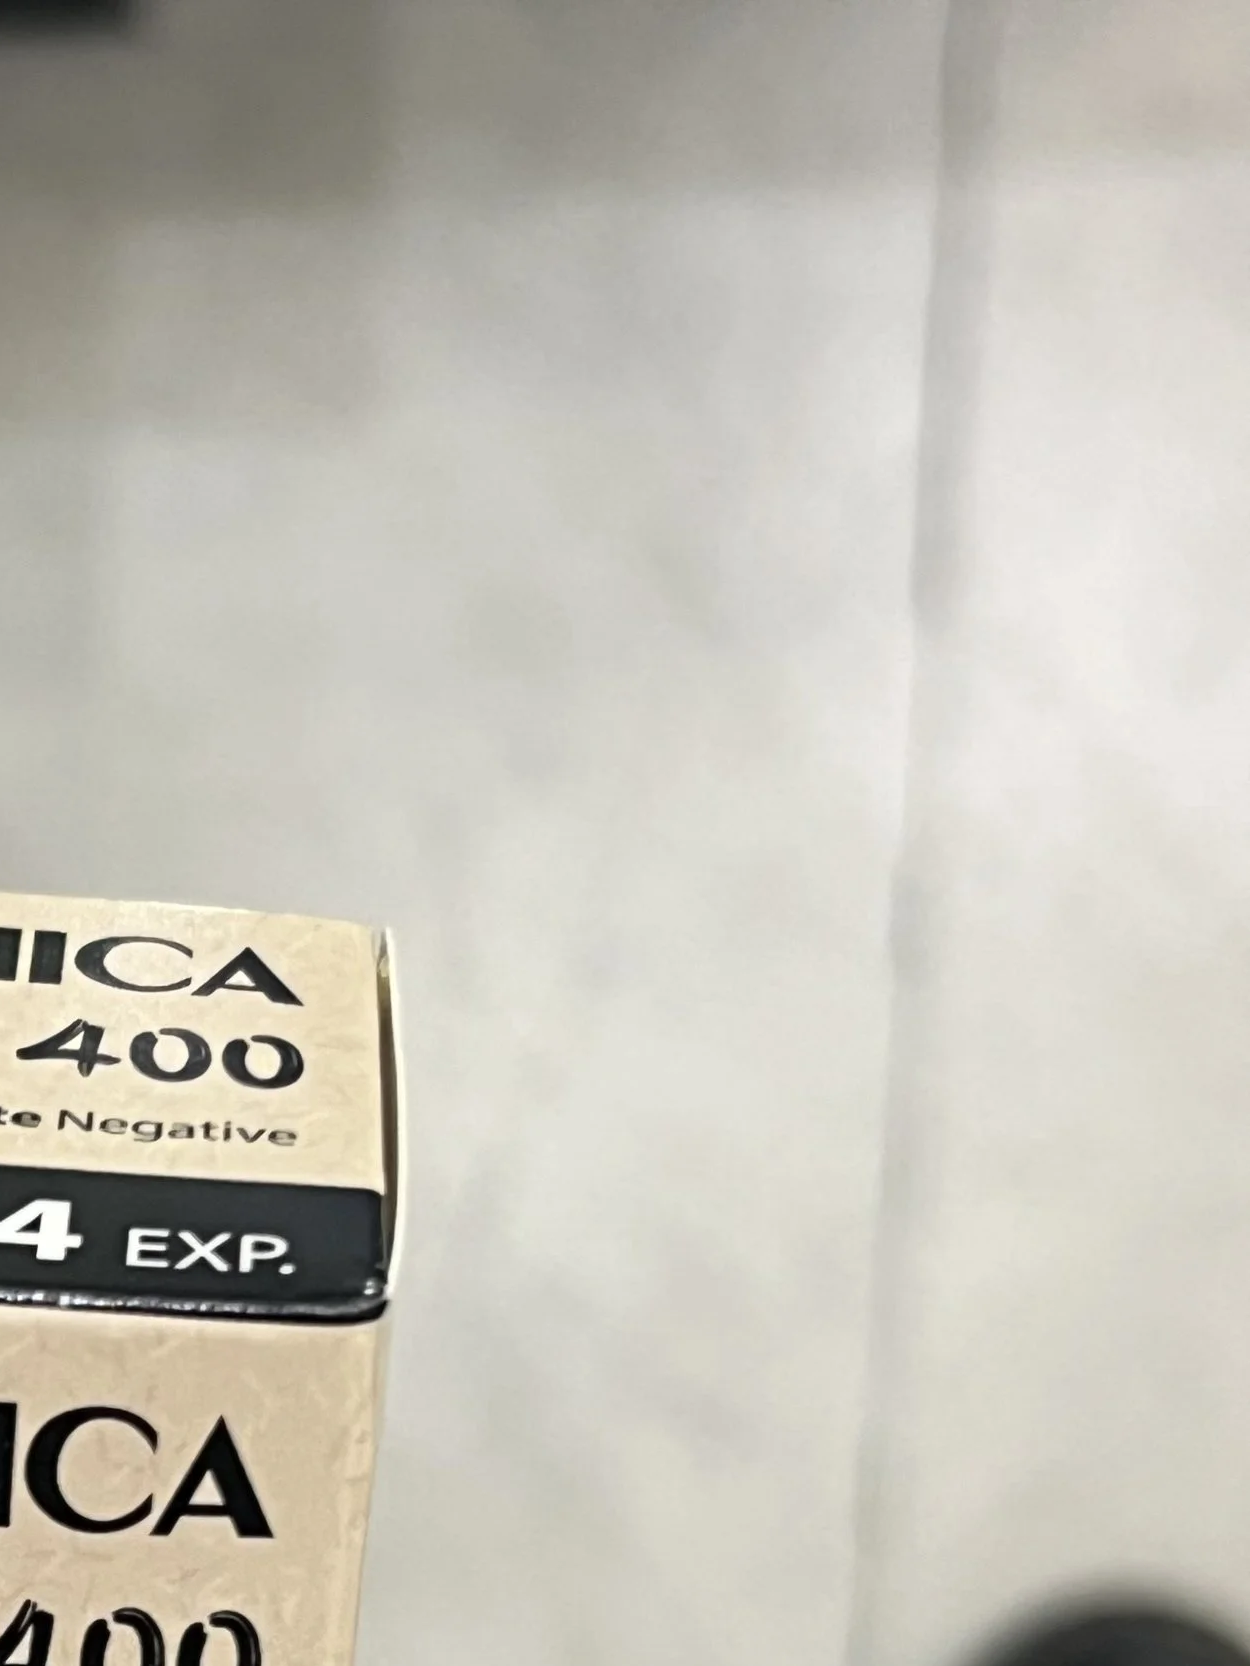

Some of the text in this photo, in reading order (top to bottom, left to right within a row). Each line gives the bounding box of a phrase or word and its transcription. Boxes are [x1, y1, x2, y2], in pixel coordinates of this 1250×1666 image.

[16, 1017, 305, 1090] 400
[56, 1108, 298, 1145] Negative
[125, 1228, 297, 1276] EXP.
